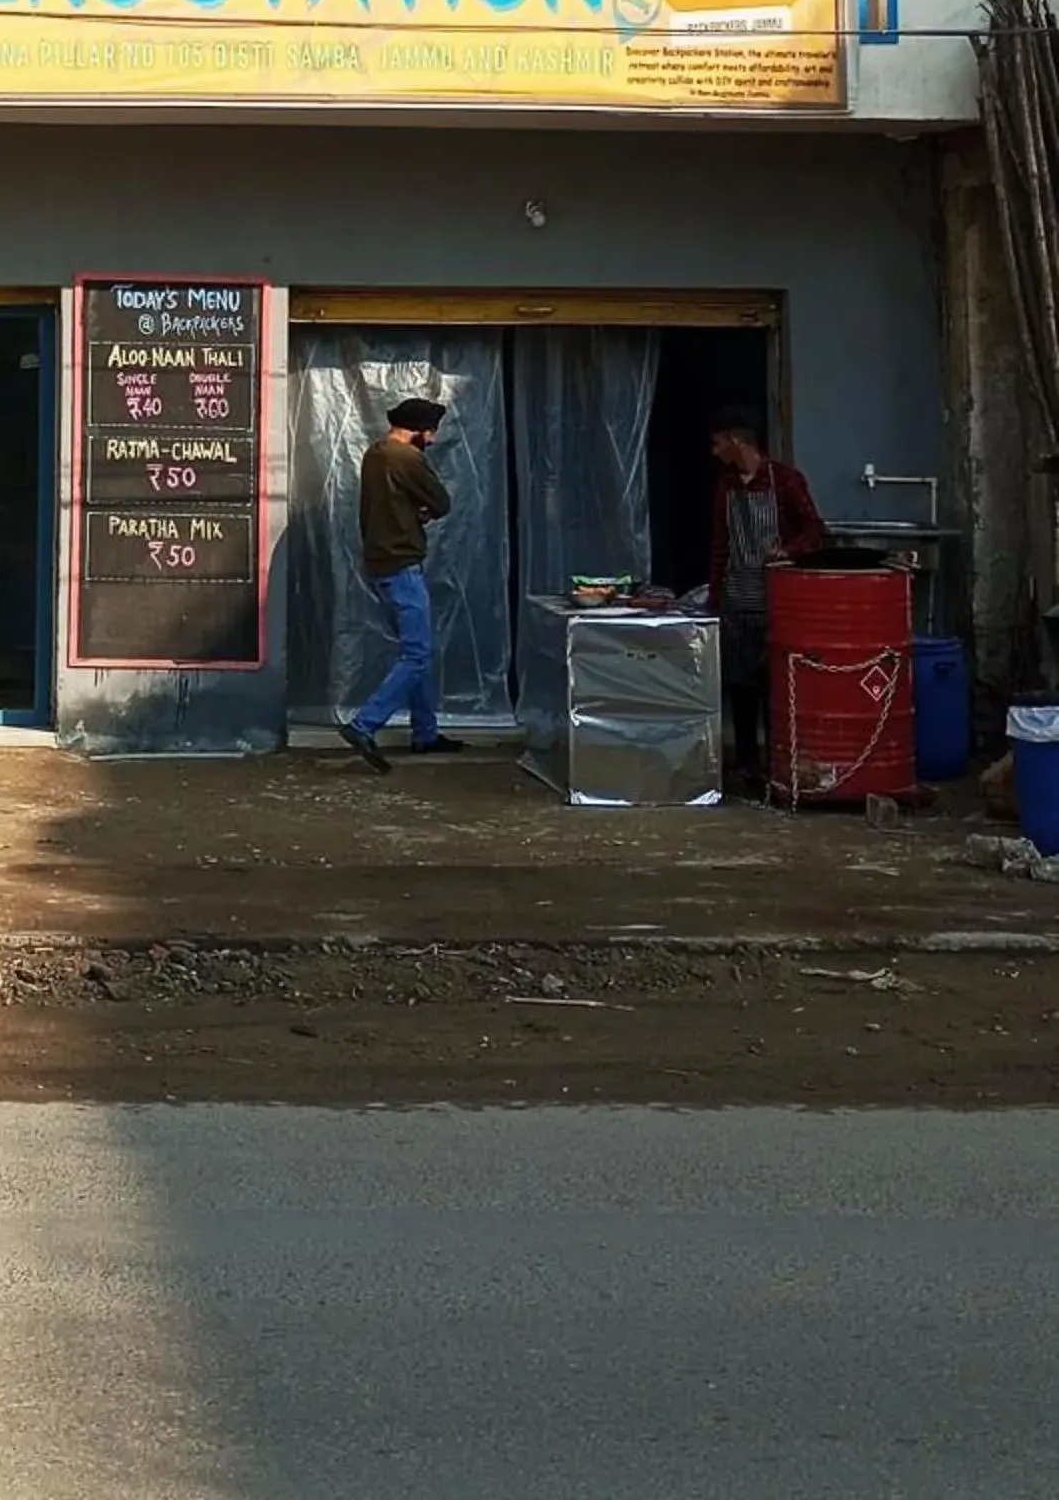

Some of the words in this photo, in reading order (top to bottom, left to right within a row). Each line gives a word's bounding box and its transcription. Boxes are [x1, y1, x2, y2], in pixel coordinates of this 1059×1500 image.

[40, 41, 116, 69] PILLAR
[378, 43, 452, 73] JAMMU
[463, 43, 504, 74] AND
[515, 44, 616, 77] KASHMIR
[111, 284, 178, 310] TODAY'S
[188, 288, 240, 311] MENU
[202, 347, 244, 367] THALI
[116, 372, 157, 386] SINGLE
[189, 372, 232, 384] DOUBLE
[125, 386, 152, 397] NAAN
[194, 384, 225, 397] NAAN
[108, 515, 179, 540] PARATHA
[190, 517, 224, 541] MIX
